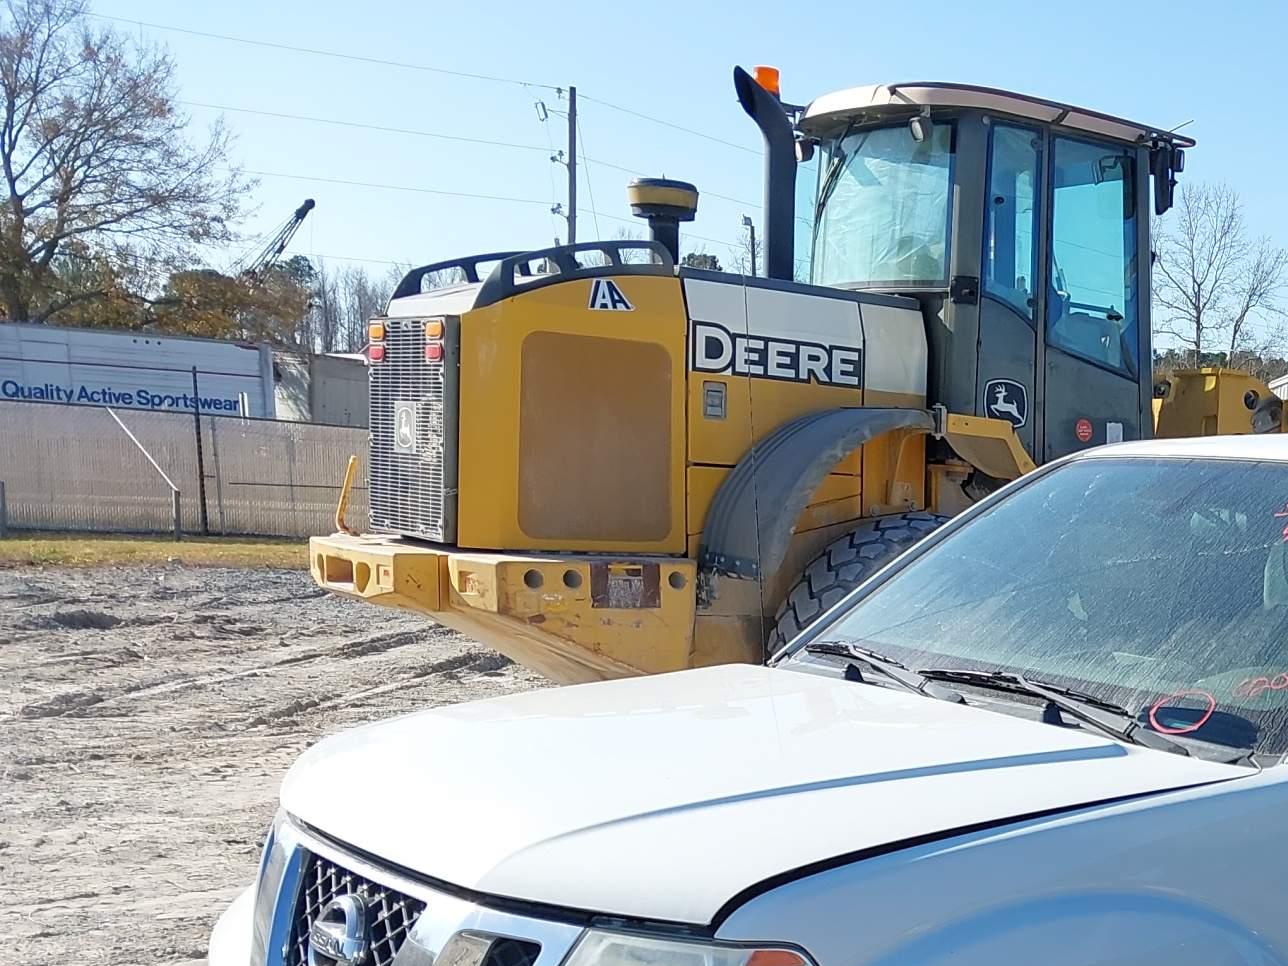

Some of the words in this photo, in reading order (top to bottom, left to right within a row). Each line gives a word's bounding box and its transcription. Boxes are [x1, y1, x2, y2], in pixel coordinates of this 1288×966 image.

[693, 322, 861, 387] DEERE
[2, 380, 74, 402] Quality
[77, 385, 133, 405] Active
[136, 389, 239, 411] Sportswear
